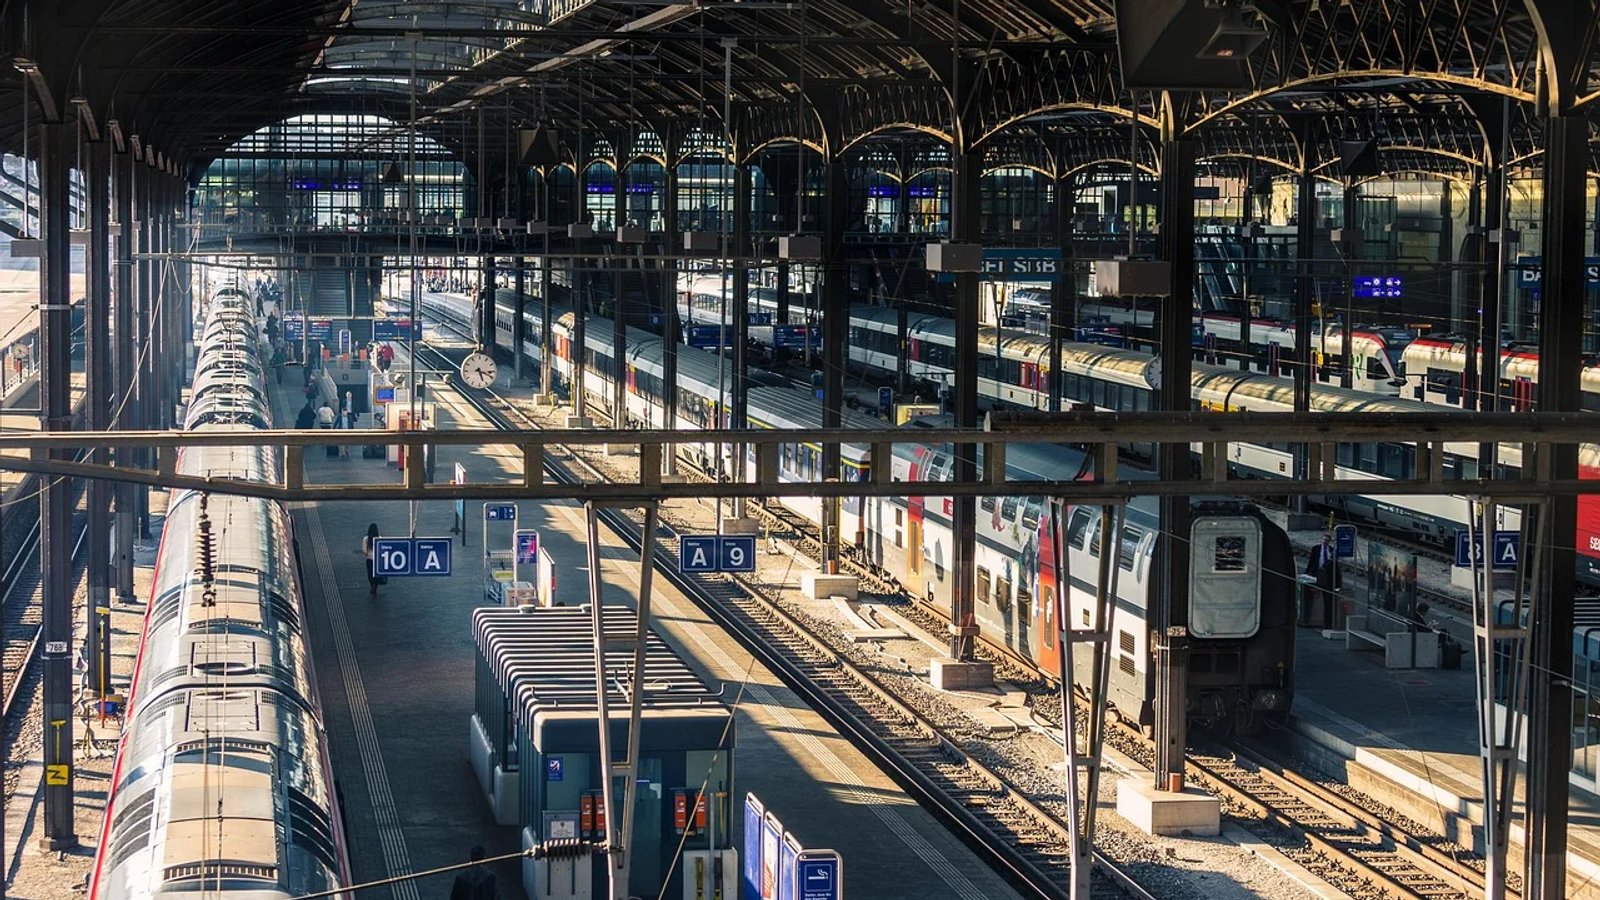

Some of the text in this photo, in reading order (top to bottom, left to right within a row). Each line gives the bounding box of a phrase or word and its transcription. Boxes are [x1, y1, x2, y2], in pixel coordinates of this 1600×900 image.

[381, 551, 406, 570] 10
[424, 551, 440, 570] A
[691, 547, 708, 567] A
[730, 547, 744, 566] 9
[1502, 542, 1516, 561] A
